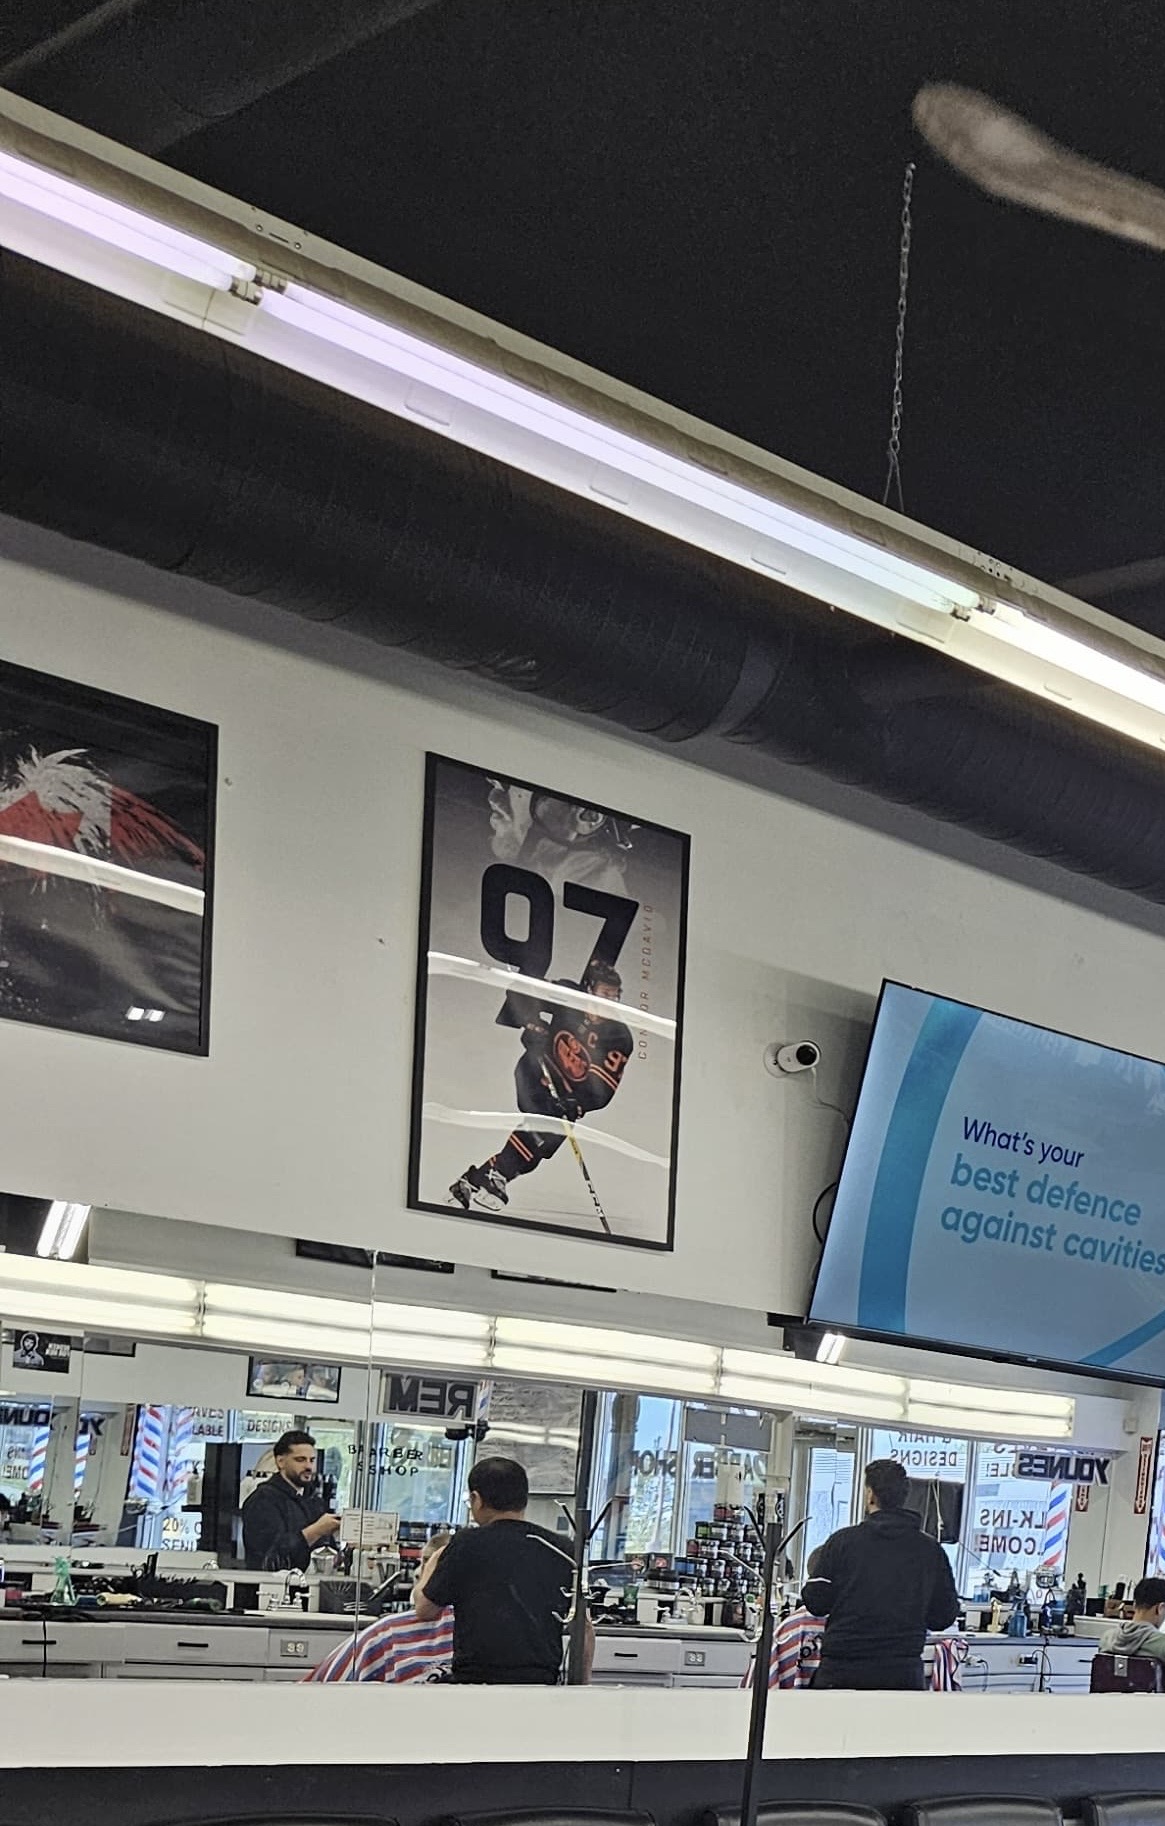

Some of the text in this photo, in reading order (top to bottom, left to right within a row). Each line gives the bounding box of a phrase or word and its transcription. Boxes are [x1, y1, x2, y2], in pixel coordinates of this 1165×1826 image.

[963, 1116, 1085, 1168] What's your
[951, 1153, 1142, 1227] best defence
[941, 1206, 1057, 1251] against
